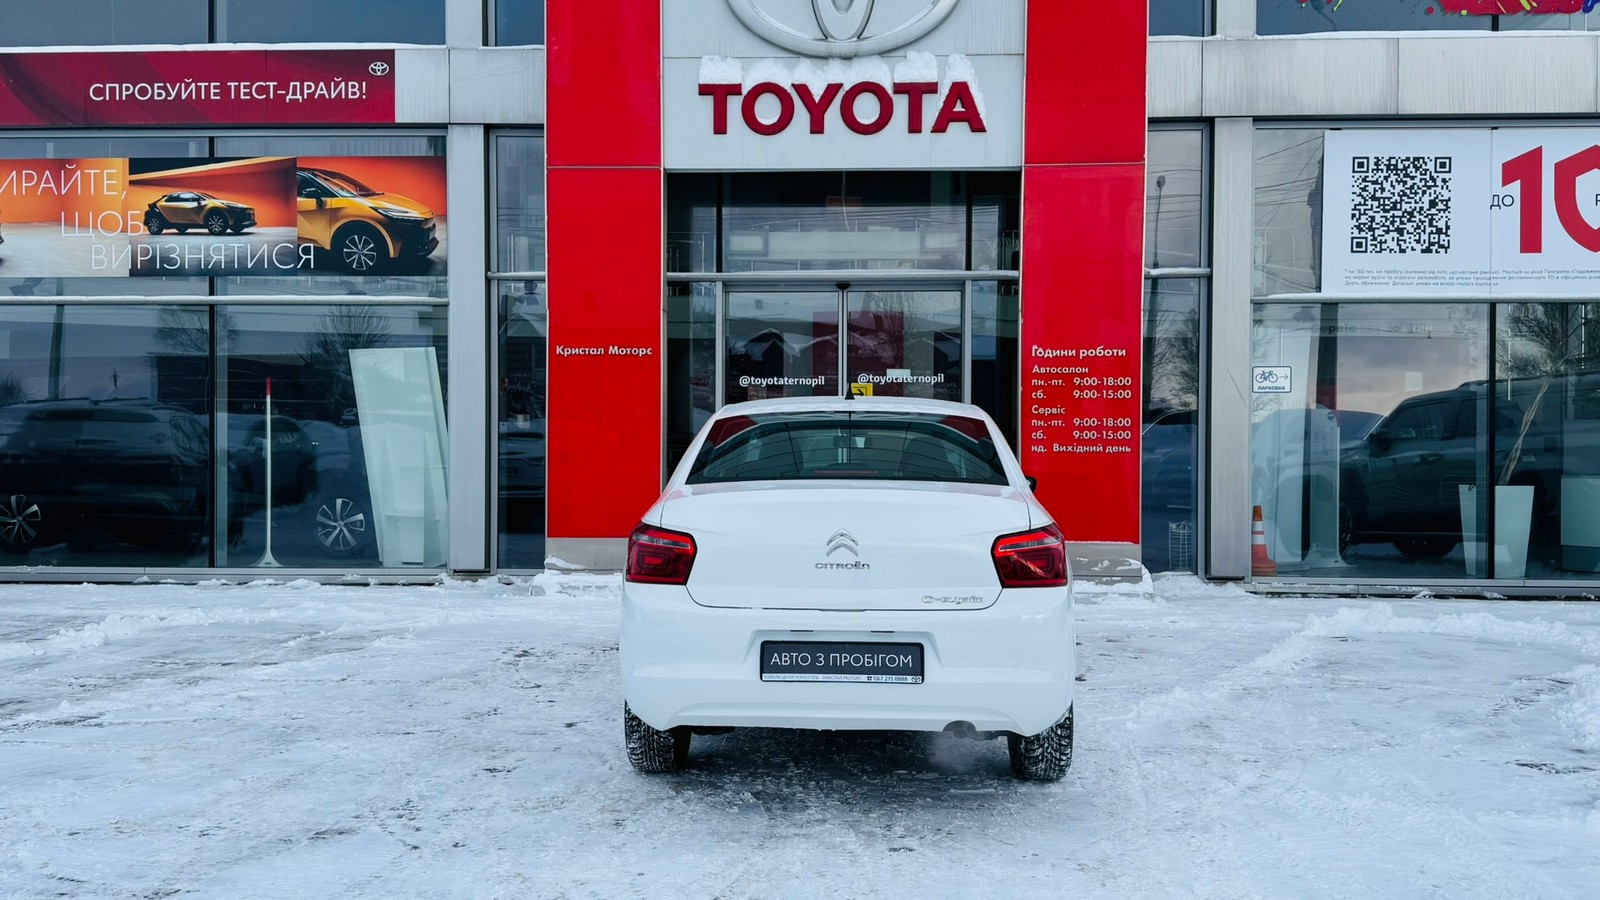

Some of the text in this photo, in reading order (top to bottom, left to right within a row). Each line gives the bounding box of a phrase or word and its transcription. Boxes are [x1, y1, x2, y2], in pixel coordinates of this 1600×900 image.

[89, 77, 367, 103] СПРОБУЙТЕ ТЕСТ-ДРАЙВ!
[699, 81, 988, 135] TOYOTA
[1490, 194, 1515, 210] ДО
[61, 210, 144, 240] ЩОБ
[91, 243, 315, 269] ВИРІЗНЯТИСЯ
[556, 345, 653, 356] Кристал Моторс
[1032, 346, 1126, 359] Години роботи
[1032, 365, 1089, 374] Автосалон
[739, 374, 825, 388] @toyotaternopil
[857, 372, 944, 386] @toyotaternopil
[1073, 377, 1132, 386] 9:00-18:00
[1031, 389, 1132, 399] сб. 9:00-15:00
[1031, 404, 1066, 416] Сервіс
[1031, 418, 1132, 427] пн.-пт. 9:00-18:00
[1031, 430, 1132, 439] сб. 9:00-15:00
[1031, 443, 1132, 453] нд. Вихідний день
[770, 652, 913, 668] АВТО З ПРОБІГОМ
